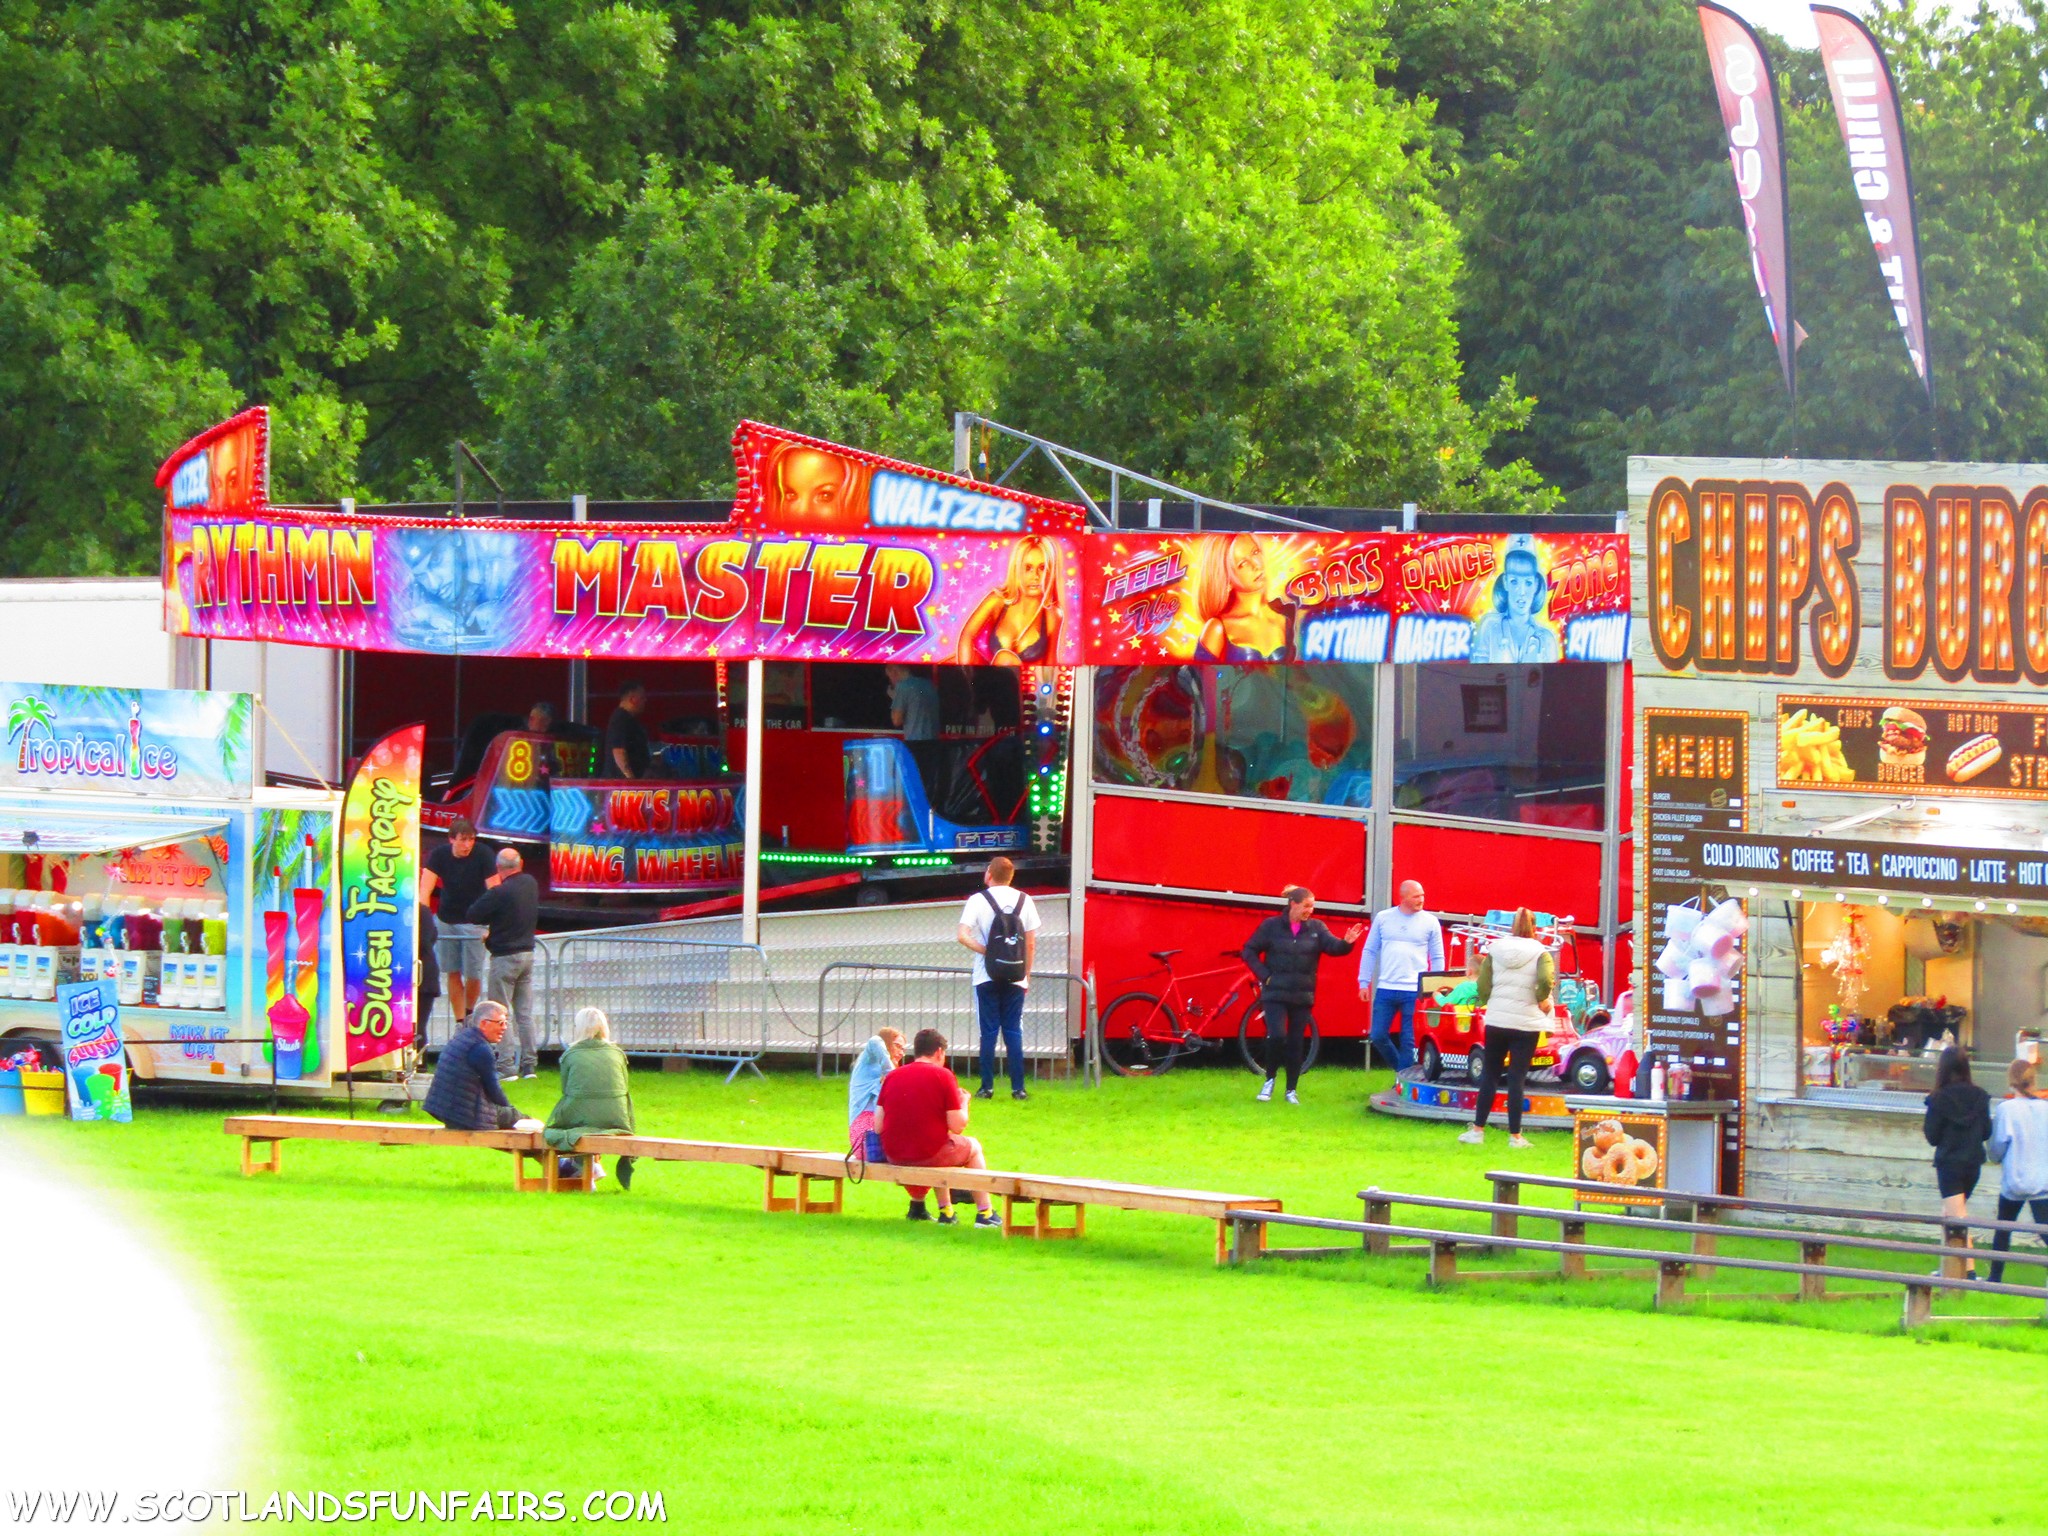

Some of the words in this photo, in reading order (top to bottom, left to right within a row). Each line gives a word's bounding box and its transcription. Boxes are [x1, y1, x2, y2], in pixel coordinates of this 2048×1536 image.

[872, 476, 1025, 530] WALTZER
[192, 524, 377, 608] RYTHMN
[1102, 550, 1187, 606] FEEL
[1288, 547, 1385, 606] BASS
[1402, 543, 1496, 593] DANCE
[1655, 489, 1853, 666] CHIPS
[551, 537, 935, 636] MASTER
[1122, 593, 1181, 632] The
[1395, 615, 1471, 663] MASTER
[766, 719, 782, 729] THE
[785, 720, 802, 730] CAR
[1838, 709, 1873, 728] CHIPS
[1948, 713, 1972, 733] HOT
[1975, 714, 1999, 733] DOG
[506, 740, 533, 782] 8
[1656, 734, 1735, 779] MENU
[1877, 764, 1926, 783] BURGER
[611, 789, 672, 833] UK'S
[677, 789, 718, 834] NO
[1653, 792, 1671, 801] BURGER
[1653, 813, 1671, 821] CHICKEN
[1685, 814, 1703, 822] BURGER
[346, 777, 413, 921] FACTORY
[1703, 843, 1733, 867] COLD
[1736, 845, 1780, 870] DRINKS
[1791, 848, 1835, 874] COFFEE
[1846, 852, 1869, 876] TEA
[1881, 854, 1957, 881] CAPPUCCINO
[1970, 859, 2006, 883] LATTE
[2018, 862, 2043, 885] HOT
[157, 865, 179, 886] IT
[183, 866, 213, 888] UP
[68, 1006, 116, 1036] COLD
[70, 990, 100, 1014] ICE
[69, 1025, 119, 1065] SLUSH
[170, 1024, 205, 1041] MIX
[209, 1026, 230, 1041] IT
[183, 1043, 215, 1060] UP!
[275, 1036, 301, 1051] Slush
